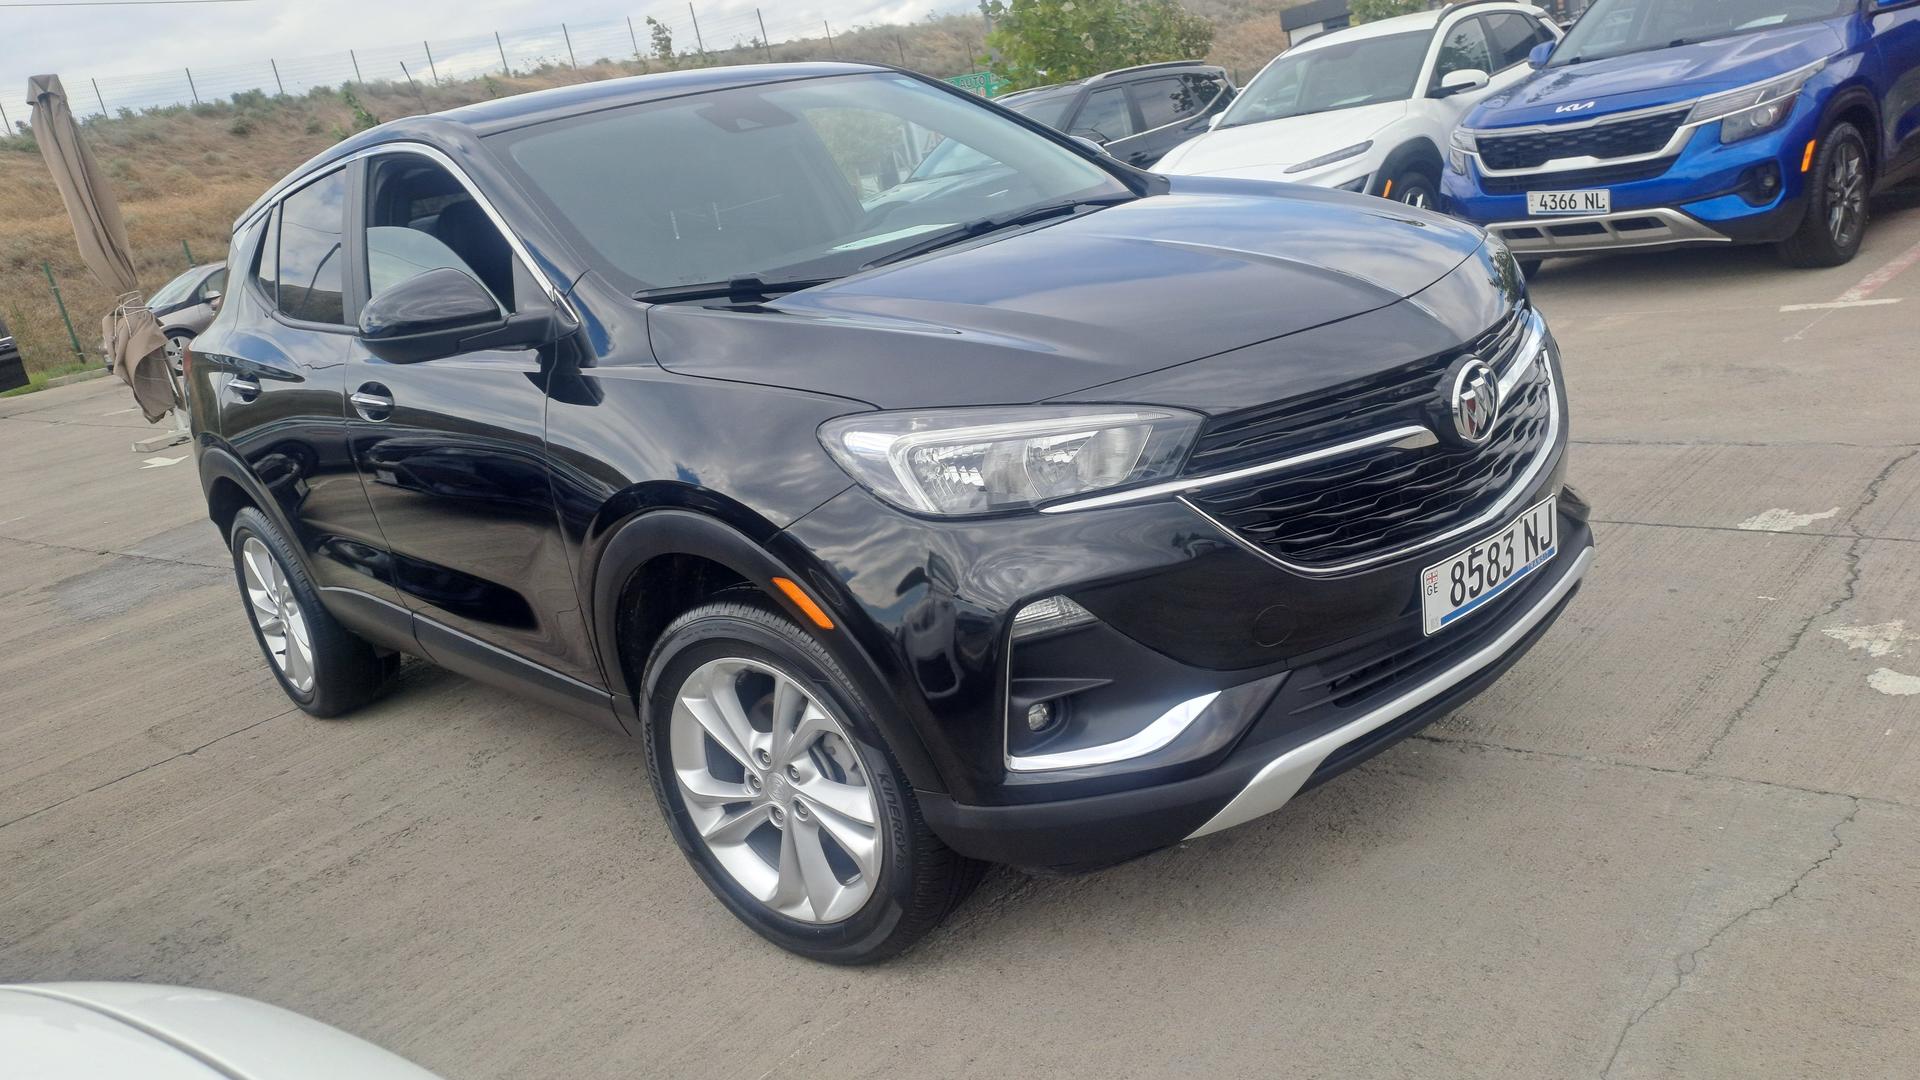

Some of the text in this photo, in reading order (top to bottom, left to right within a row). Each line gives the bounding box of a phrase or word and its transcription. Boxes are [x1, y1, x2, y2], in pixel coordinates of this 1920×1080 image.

[1555, 101, 1595, 113] KIA
[1540, 192, 1606, 210] 4366 NL
[1450, 502, 1553, 608] 8583 NJ
[1426, 582, 1439, 596] GE
